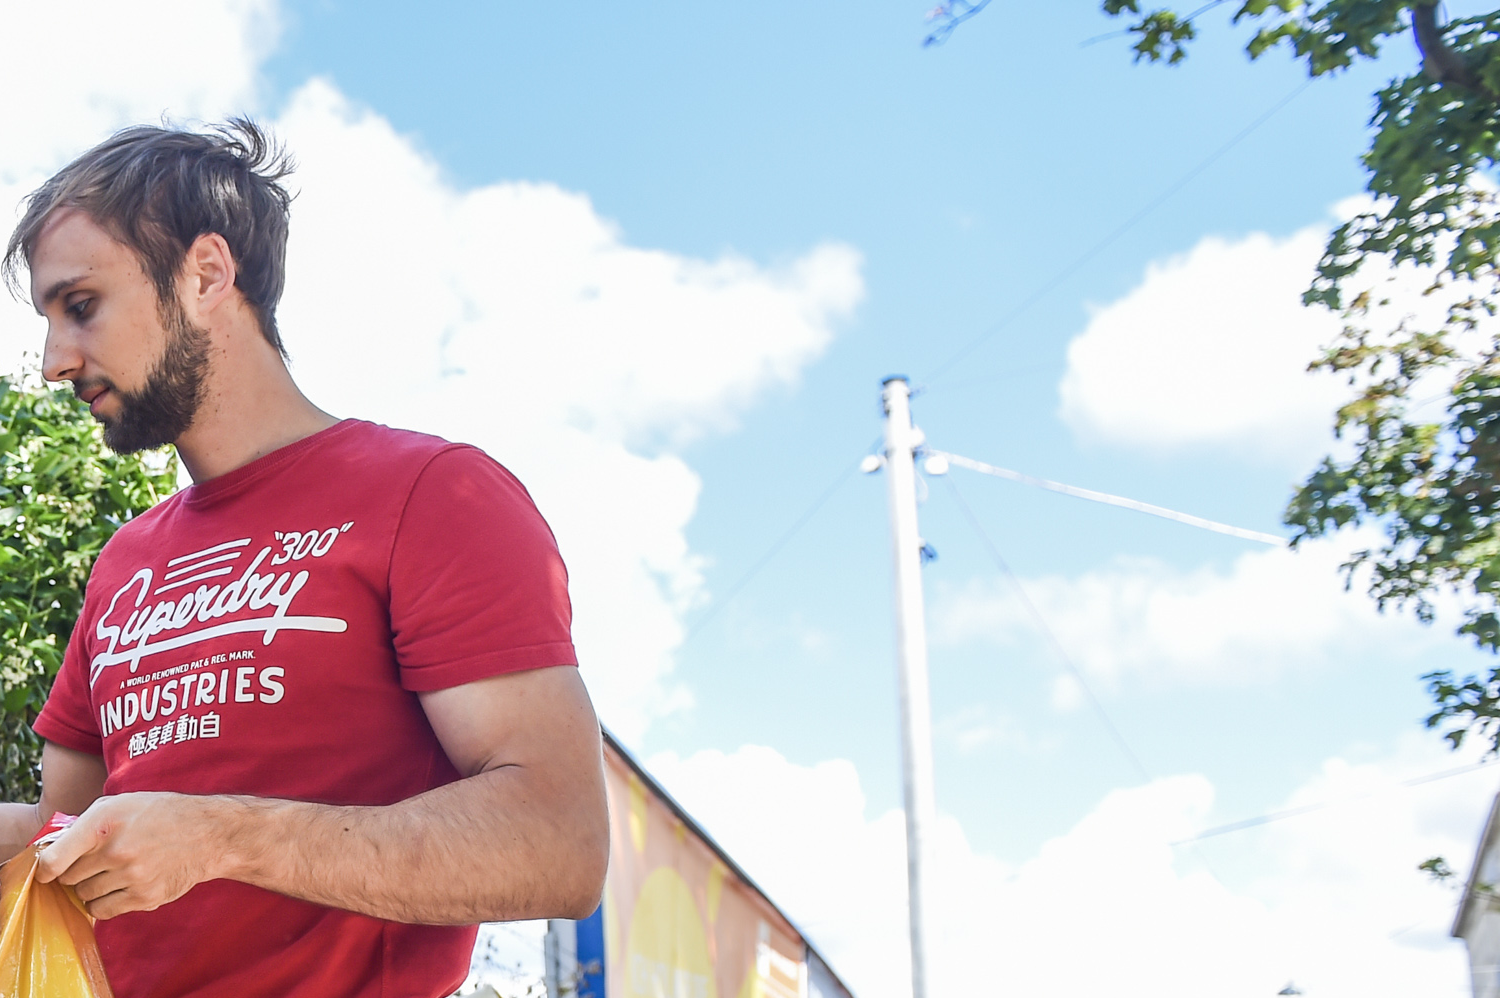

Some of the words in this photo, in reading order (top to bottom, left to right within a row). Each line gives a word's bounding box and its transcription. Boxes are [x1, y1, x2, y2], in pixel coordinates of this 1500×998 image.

[90, 546, 347, 690] Superdry
[100, 666, 286, 737] INDUSTRIES
[119, 681, 125, 689] A
[126, 674, 150, 687] WORLD
[151, 663, 189, 682] RENOWNED
[211, 654, 227, 665] REG.
[228, 650, 256, 661] MARK.
